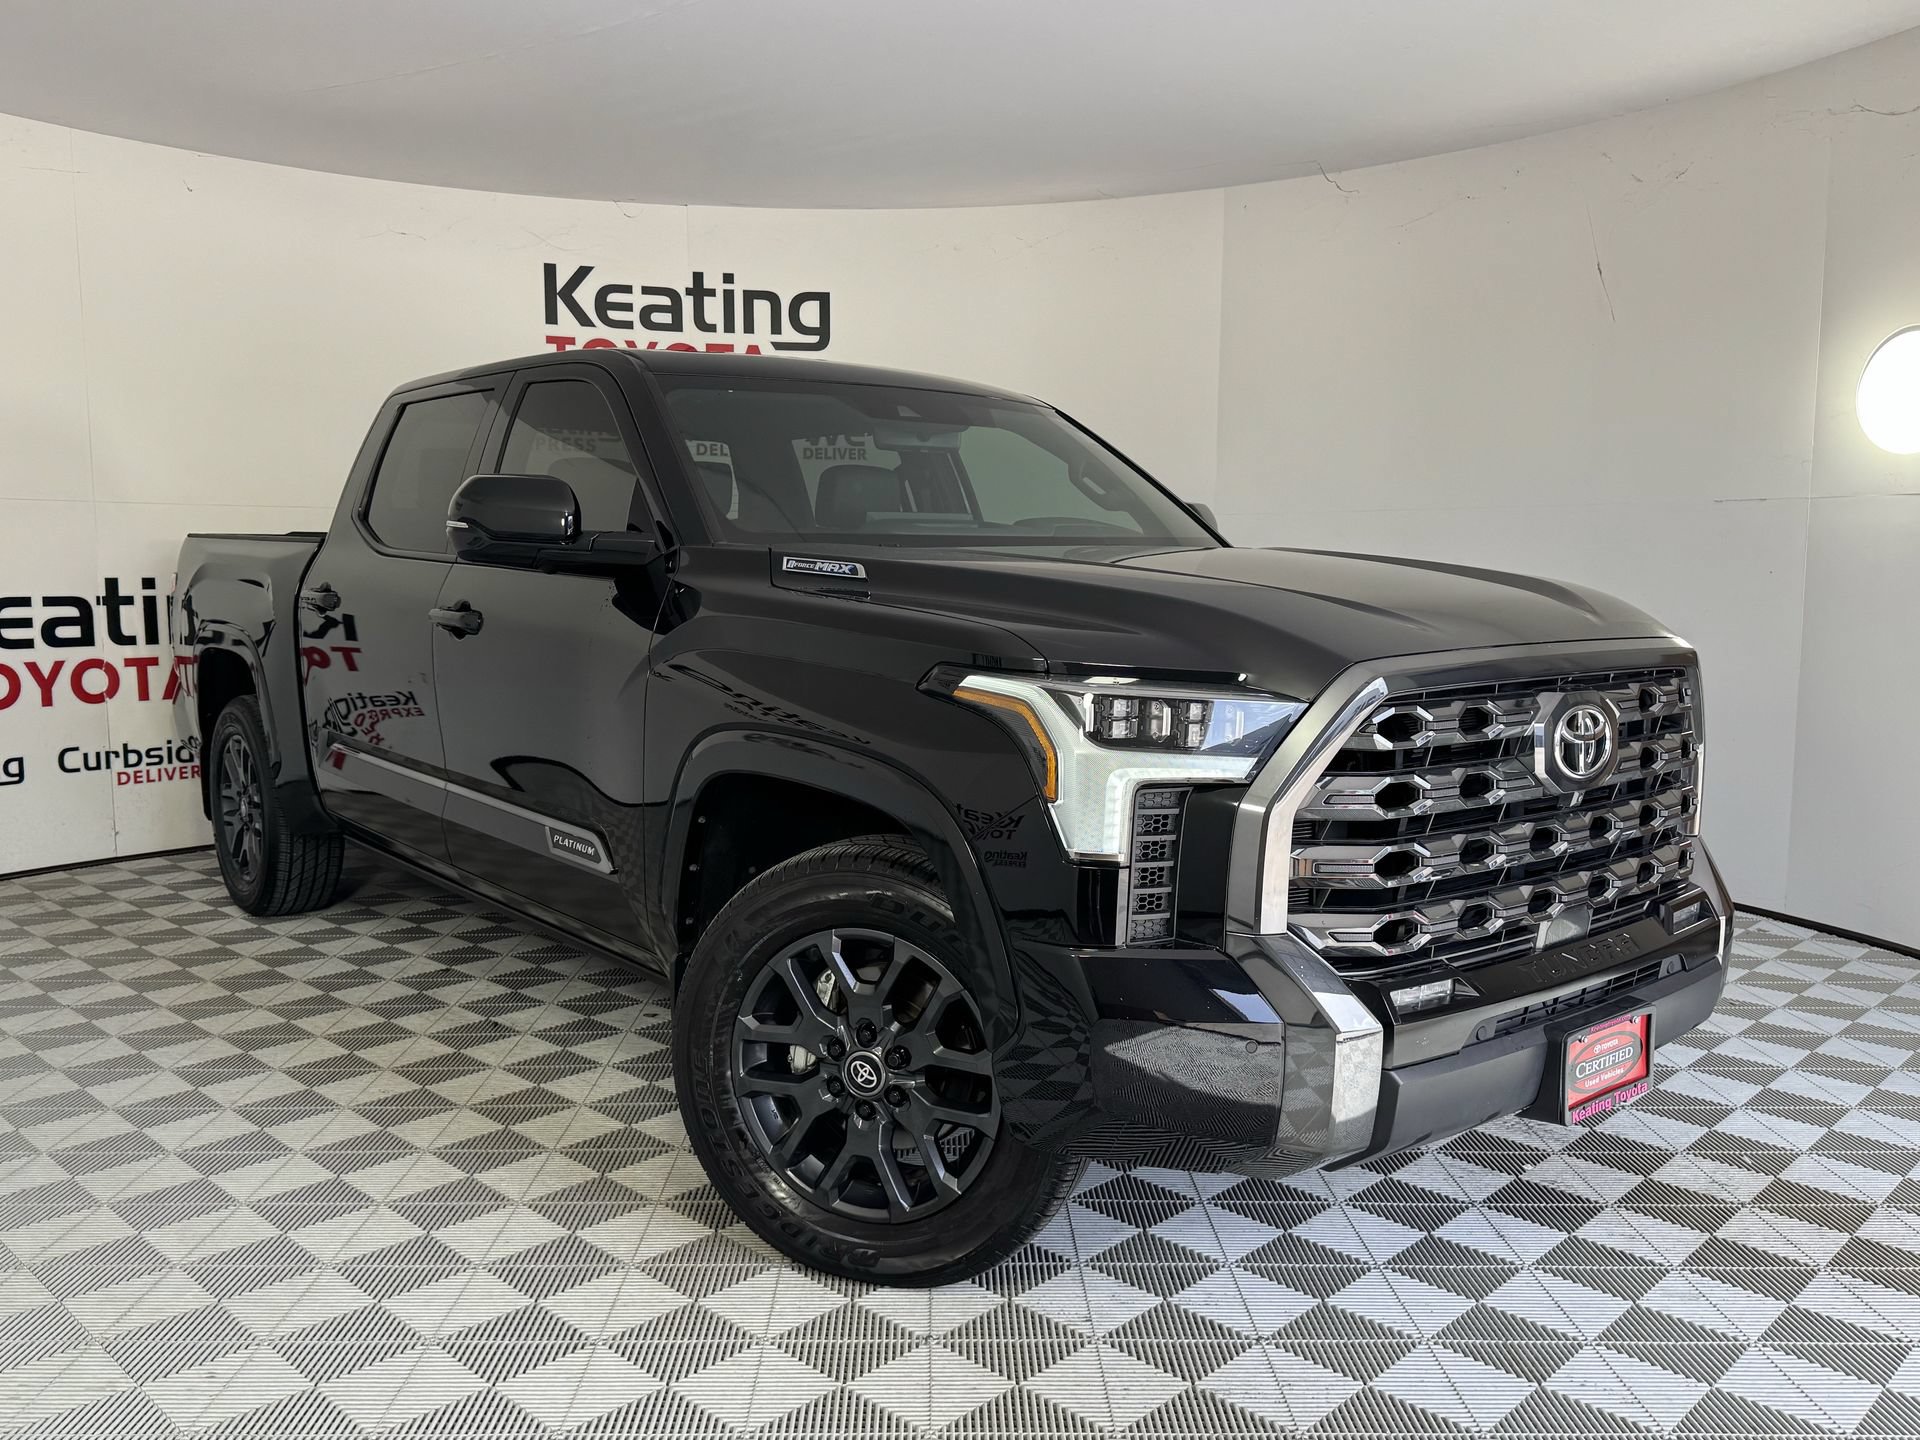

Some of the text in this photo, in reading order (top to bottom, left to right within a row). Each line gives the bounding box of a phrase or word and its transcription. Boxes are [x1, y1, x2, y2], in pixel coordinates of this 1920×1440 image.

[543, 262, 831, 352] Keating
[803, 447, 868, 461] DELIVER
[814, 562, 855, 574] MAX
[117, 765, 202, 786] DELIVER
[553, 834, 595, 856] PLATINUM
[1601, 1038, 1619, 1050] TOYOTA
[1576, 1046, 1634, 1079] CERTIFIED
[1584, 1067, 1625, 1088] Used Vehicles
[1571, 1081, 1649, 1124] Keating Toyota
